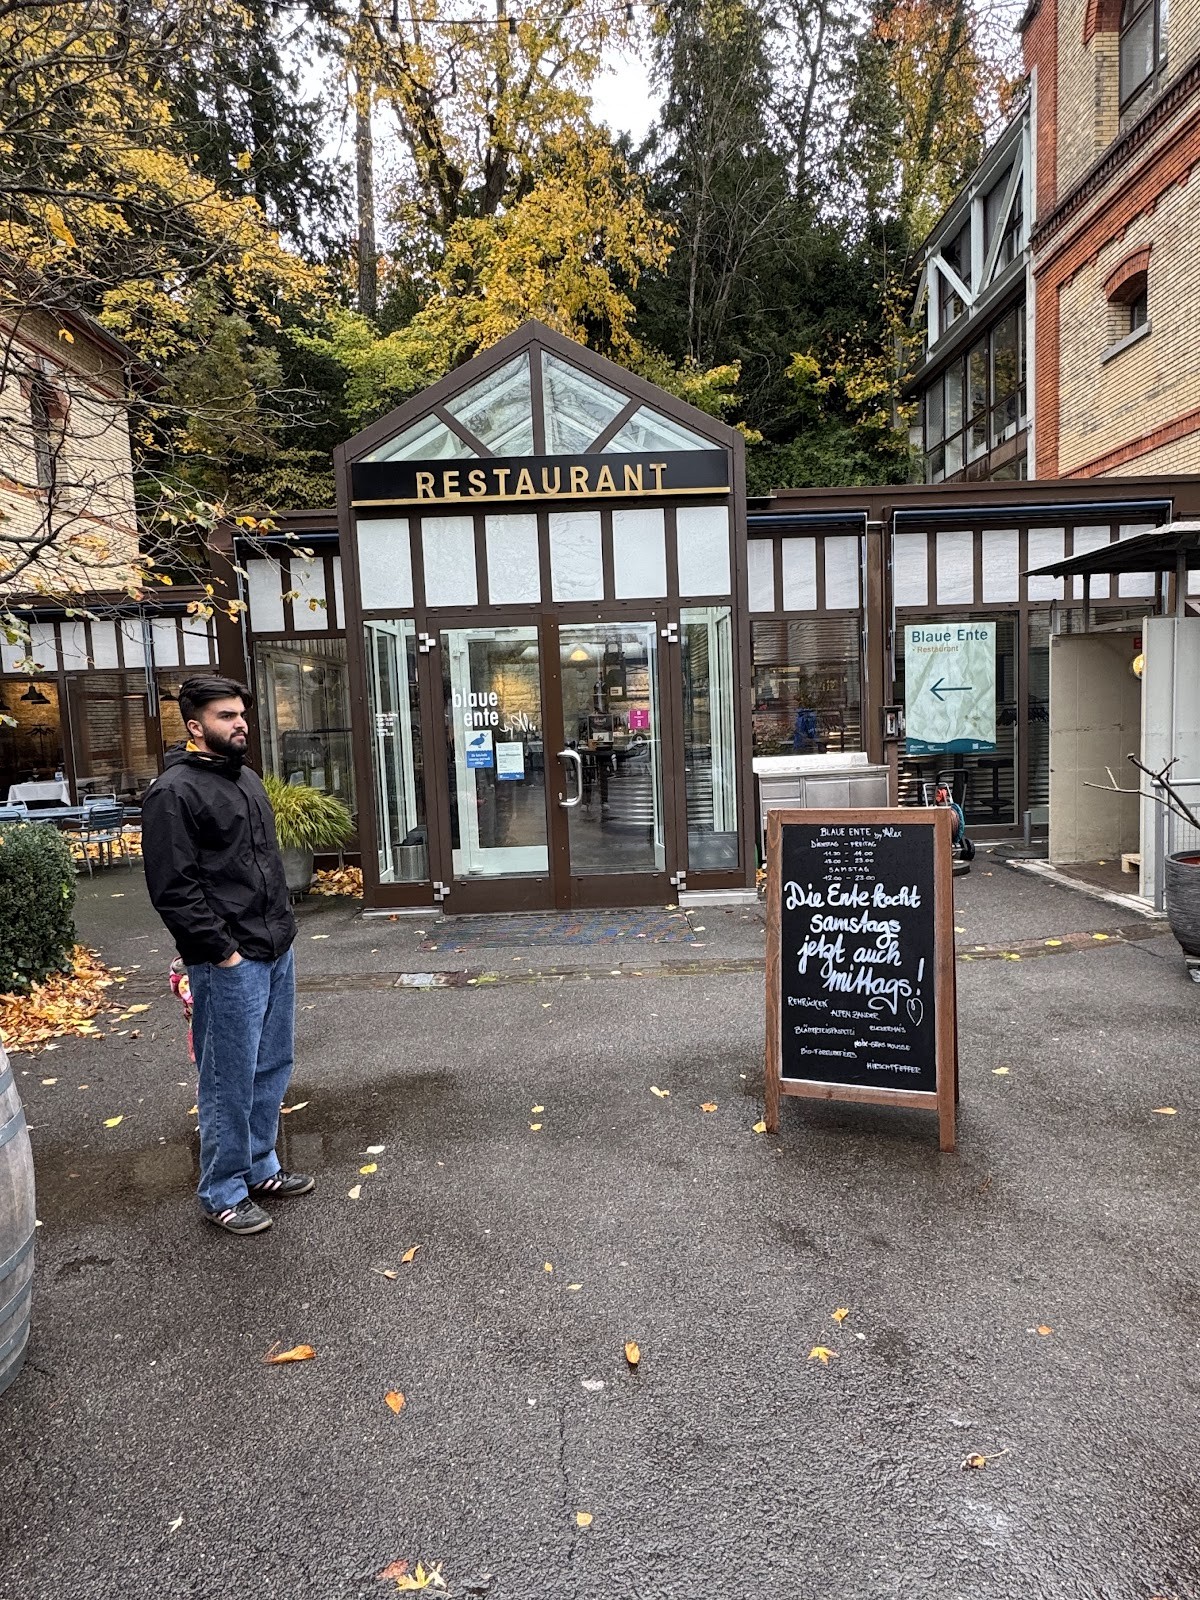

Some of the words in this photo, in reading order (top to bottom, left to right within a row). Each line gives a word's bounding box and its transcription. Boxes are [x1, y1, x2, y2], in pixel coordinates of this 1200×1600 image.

[416, 463, 668, 499] RESTAURANT
[912, 630, 951, 643] Blaue
[957, 629, 988, 641] Ente
[917, 645, 959, 653] Restaurant
[452, 688, 498, 708] blaue
[464, 708, 499, 727] ente
[820, 827, 845, 837] BLAUE
[848, 827, 872, 836] ENTE
[784, 881, 825, 910] Die
[827, 883, 871, 908] Ente
[871, 883, 921, 909] kocht
[797, 933, 846, 978] jetzt
[853, 940, 902, 967] auch
